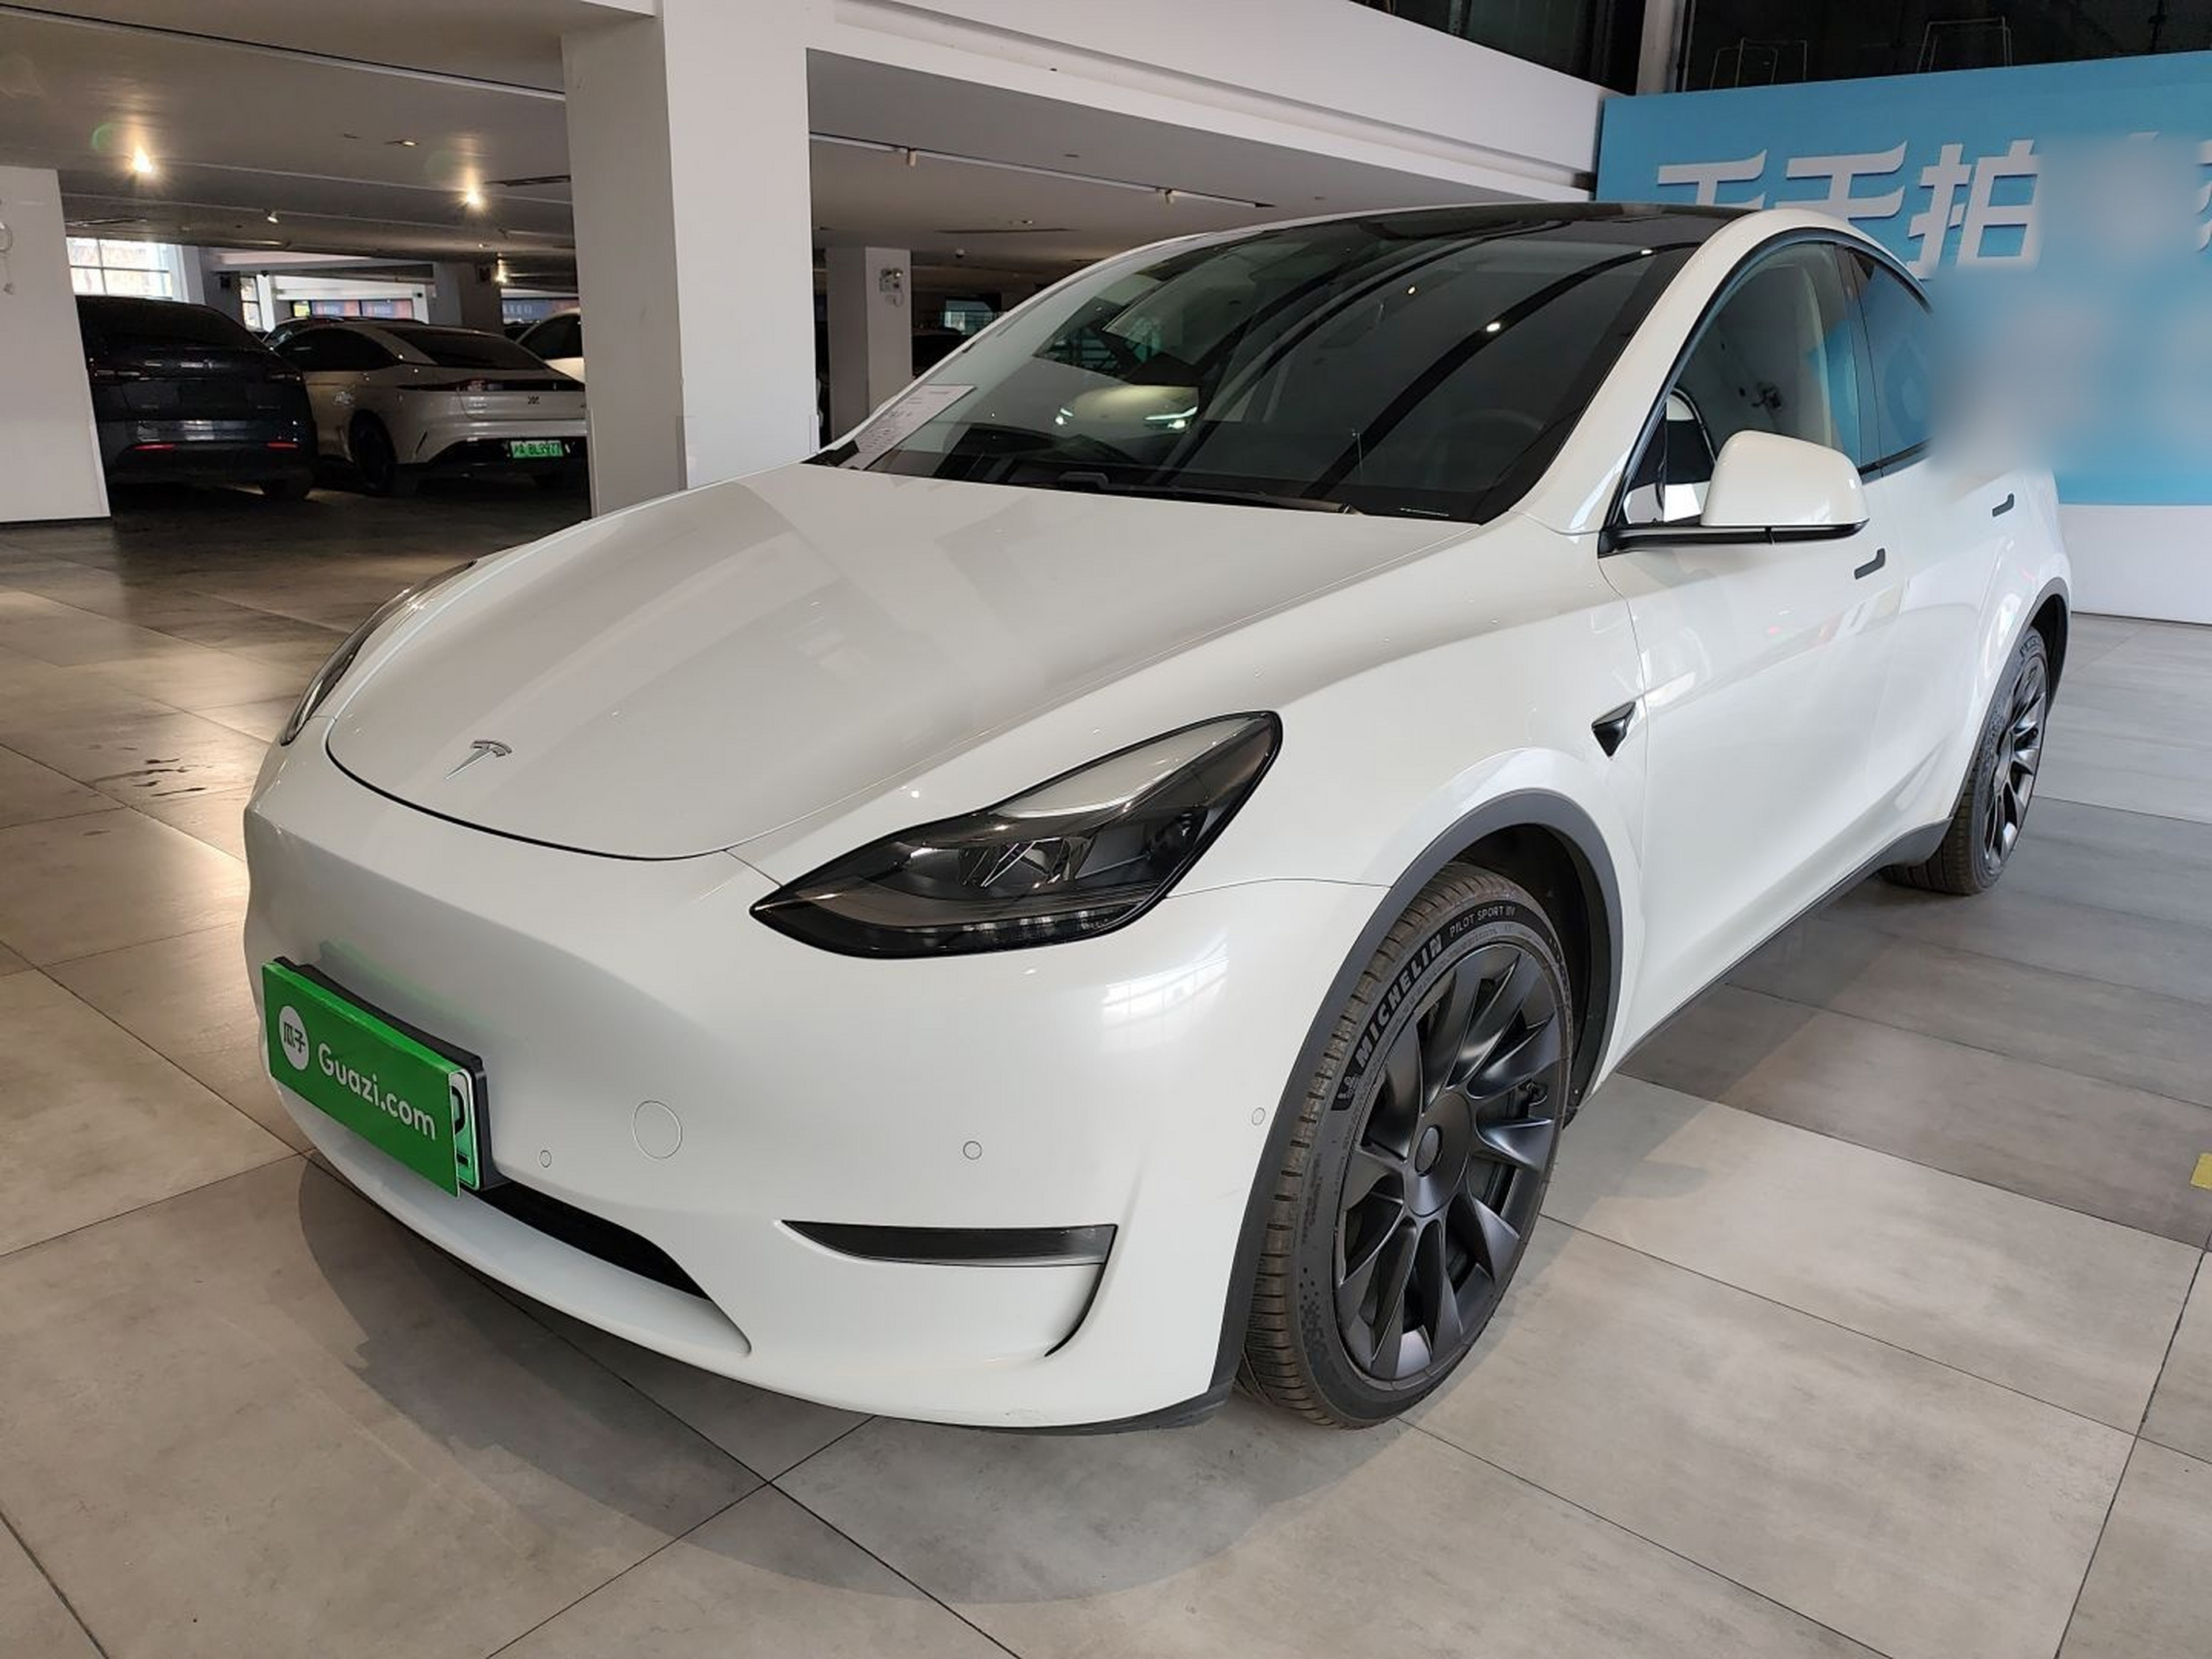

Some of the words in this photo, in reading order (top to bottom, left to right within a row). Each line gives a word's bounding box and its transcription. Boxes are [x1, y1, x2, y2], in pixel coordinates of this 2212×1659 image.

[1355, 934, 1443, 1069] MICHELIN
[1449, 913, 1475, 938] PILOT
[1477, 906, 1505, 921] SPORT
[318, 1043, 436, 1141] Guazi.com
